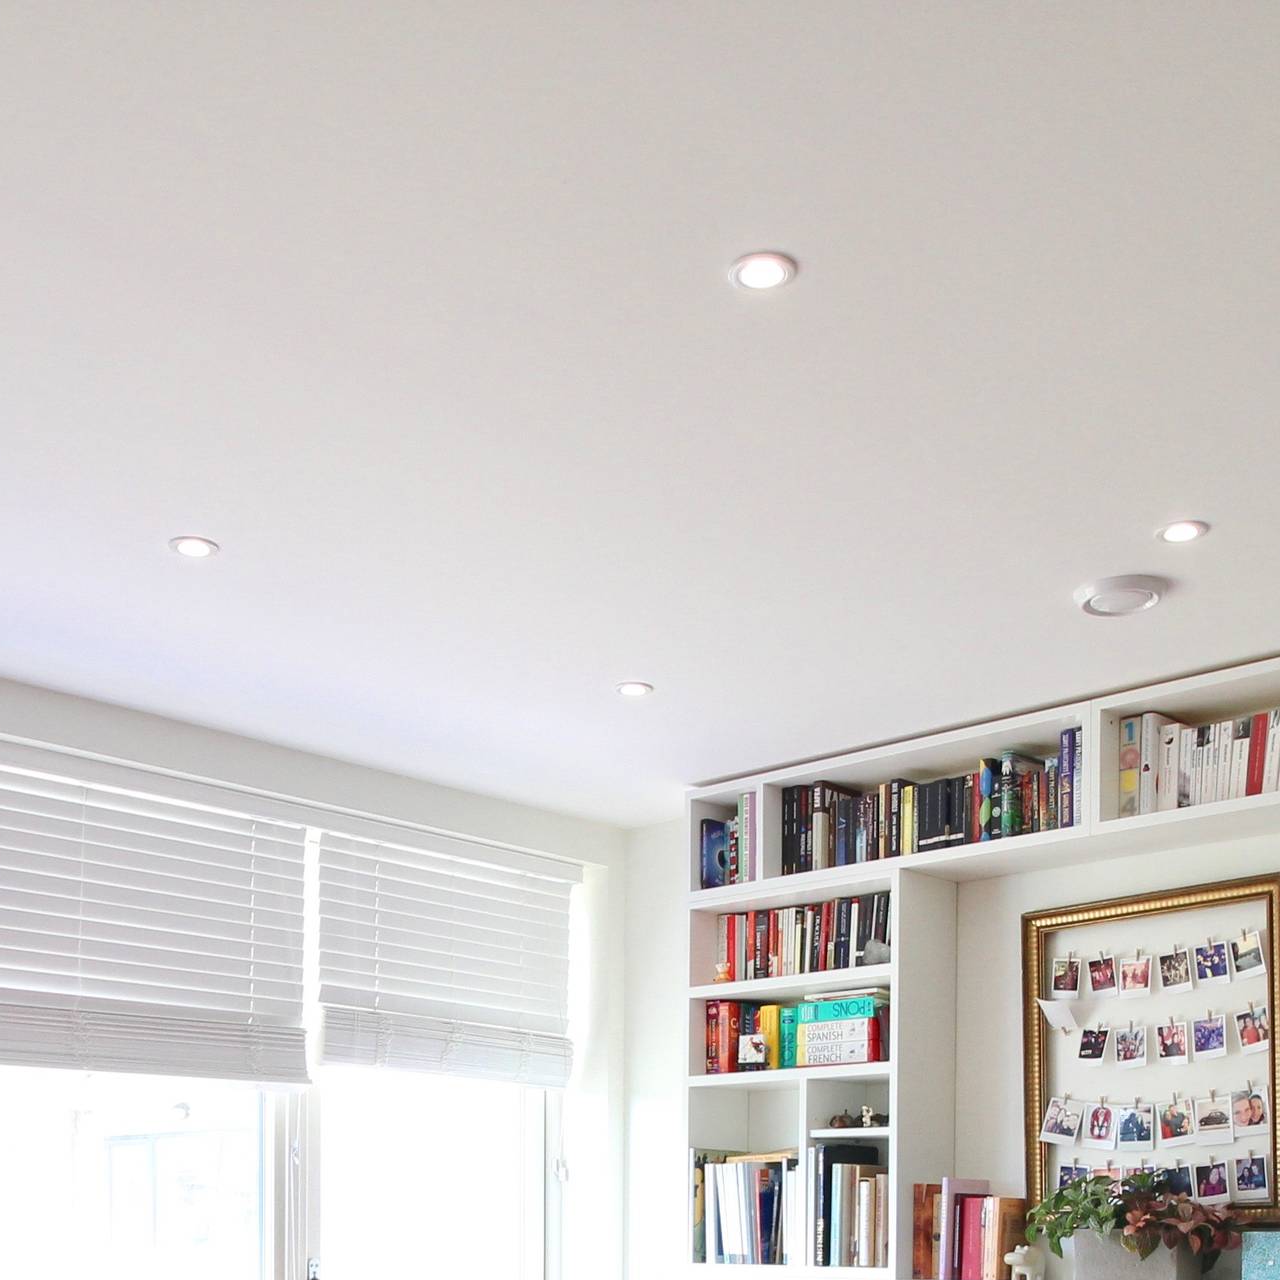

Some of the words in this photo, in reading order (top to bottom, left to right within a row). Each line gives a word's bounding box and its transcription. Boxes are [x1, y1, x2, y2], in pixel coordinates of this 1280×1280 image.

[833, 1000, 866, 1018] PONS
[807, 1022, 843, 1032] COMPLETE
[807, 1031, 844, 1043] SPANISH
[807, 1044, 843, 1054] COMPLETE
[808, 1053, 842, 1064] FRENCH
